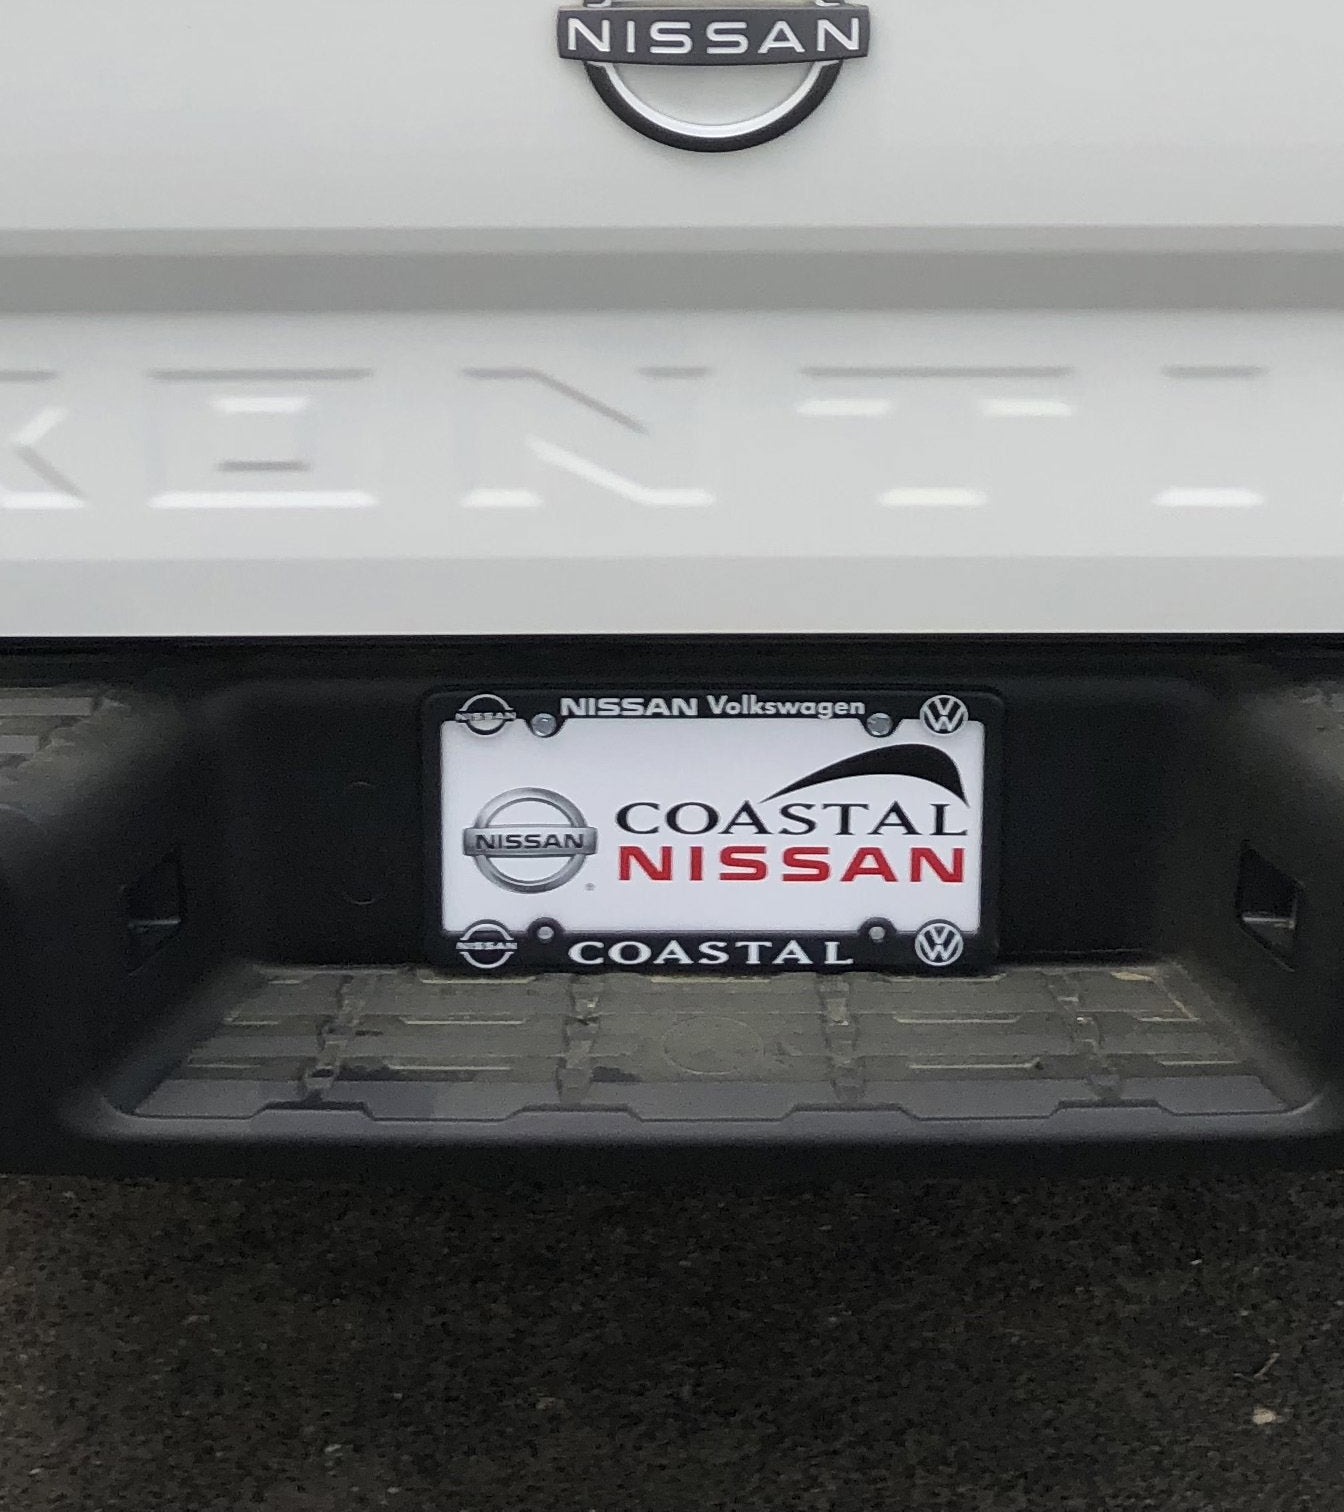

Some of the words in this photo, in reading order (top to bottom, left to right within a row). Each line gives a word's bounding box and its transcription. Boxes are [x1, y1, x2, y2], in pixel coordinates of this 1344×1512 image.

[567, 17, 860, 54] NISSAN
[560, 696, 699, 716] NISSAN
[706, 694, 866, 719] Volkswagen
[615, 800, 969, 836] COASTAL
[474, 833, 585, 850] NISSAN
[618, 845, 965, 884] NISSAN
[567, 939, 855, 965] COASTAL
